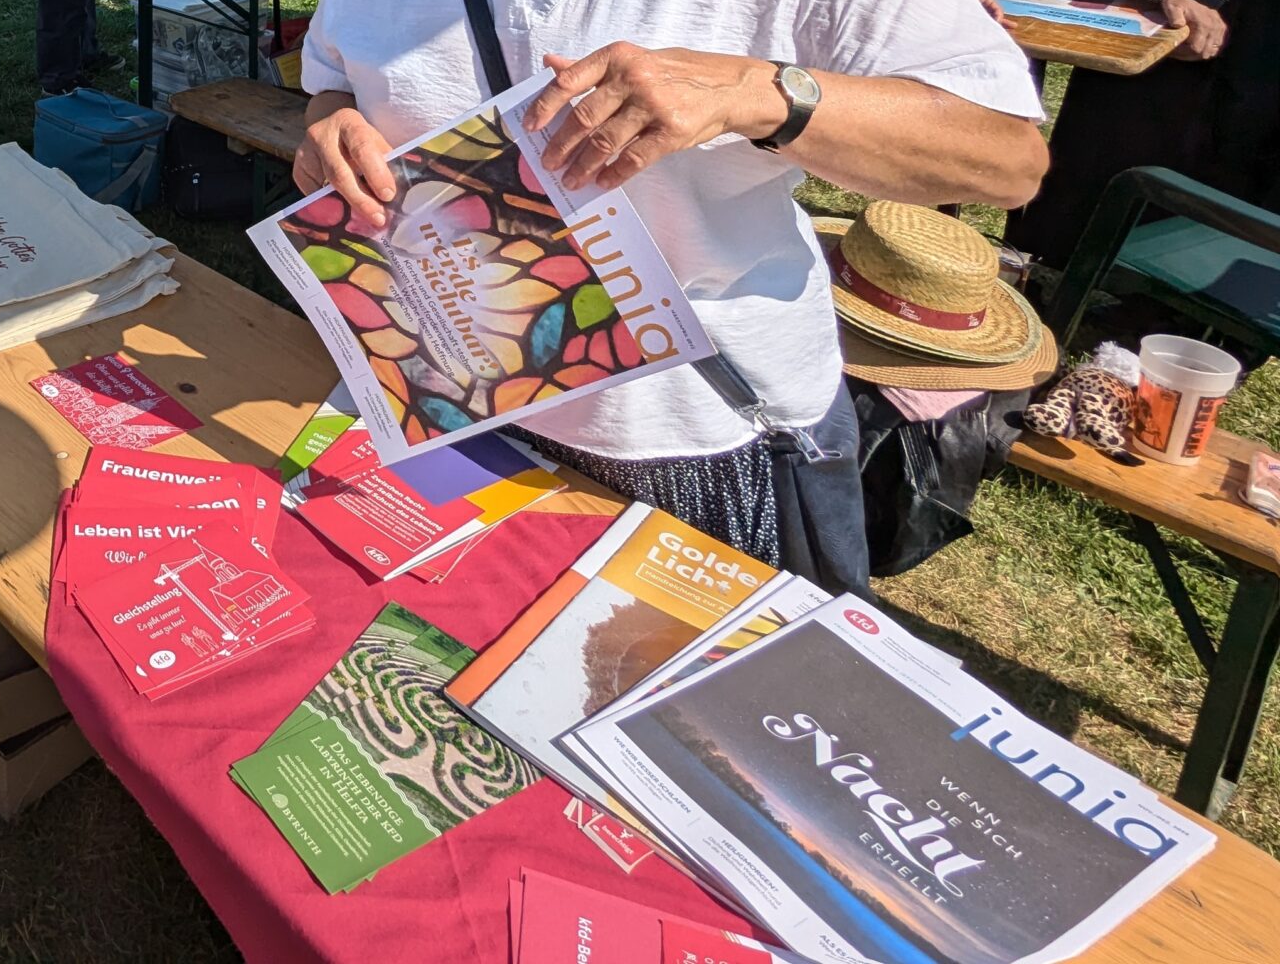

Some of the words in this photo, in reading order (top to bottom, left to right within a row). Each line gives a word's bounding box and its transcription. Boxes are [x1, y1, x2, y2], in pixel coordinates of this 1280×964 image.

[0, 236, 37, 264] Gottes
[380, 236, 391, 249] vor
[388, 248, 410, 284] massiven
[419, 222, 477, 303] werde
[451, 237, 481, 271] Es
[388, 285, 414, 323] entfachen
[551, 206, 680, 365] junia
[401, 286, 420, 317] Welche
[419, 316, 434, 341] Ideen
[431, 340, 455, 378] Hoffnung
[403, 259, 421, 284] Kirche
[419, 284, 431, 300] und
[428, 300, 458, 347] Gesellschaft
[455, 346, 474, 375] stehen
[1182, 397, 1216, 456] GIANTS
[356, 482, 372, 493] und
[371, 492, 396, 509] Schutz
[395, 507, 410, 518] des
[409, 517, 436, 535] Lebens
[363, 478, 377, 487] auf
[376, 486, 443, 532] Selbstbestimmung
[370, 474, 403, 497] Zwischen
[404, 496, 425, 511] Recht
[74, 524, 132, 538] Leben
[138, 524, 162, 538] ist
[368, 548, 388, 564] kfd
[104, 550, 136, 564] Wir
[647, 545, 732, 596] Licht
[659, 532, 765, 588] Golde
[113, 586, 183, 625] Gleichstellung
[644, 569, 702, 603] Handreichung
[702, 598, 717, 608] zur
[136, 622, 149, 632] Es
[148, 615, 161, 629] gibt
[160, 606, 181, 623] immer
[149, 628, 165, 640] was
[164, 625, 174, 635] zu
[172, 615, 187, 632] tun!
[850, 613, 874, 631] kfd
[154, 652, 171, 667] kfd
[309, 736, 363, 795] LABYRINTH
[359, 796, 383, 819] DER
[379, 819, 403, 843] KFD
[328, 741, 352, 764] DAS
[348, 764, 404, 826] LEBENDIGE
[613, 736, 627, 750] WIE
[625, 747, 639, 763] WIR
[636, 759, 660, 784] BESSER
[658, 779, 692, 814] SCHLAFEN
[950, 706, 1179, 860] junia
[331, 779, 370, 823] HELFTA
[762, 712, 986, 898] Nacht
[939, 776, 1001, 826] WENN
[926, 798, 962, 827] DIE
[971, 818, 1023, 859] SICH
[858, 831, 948, 904] ERHELLT
